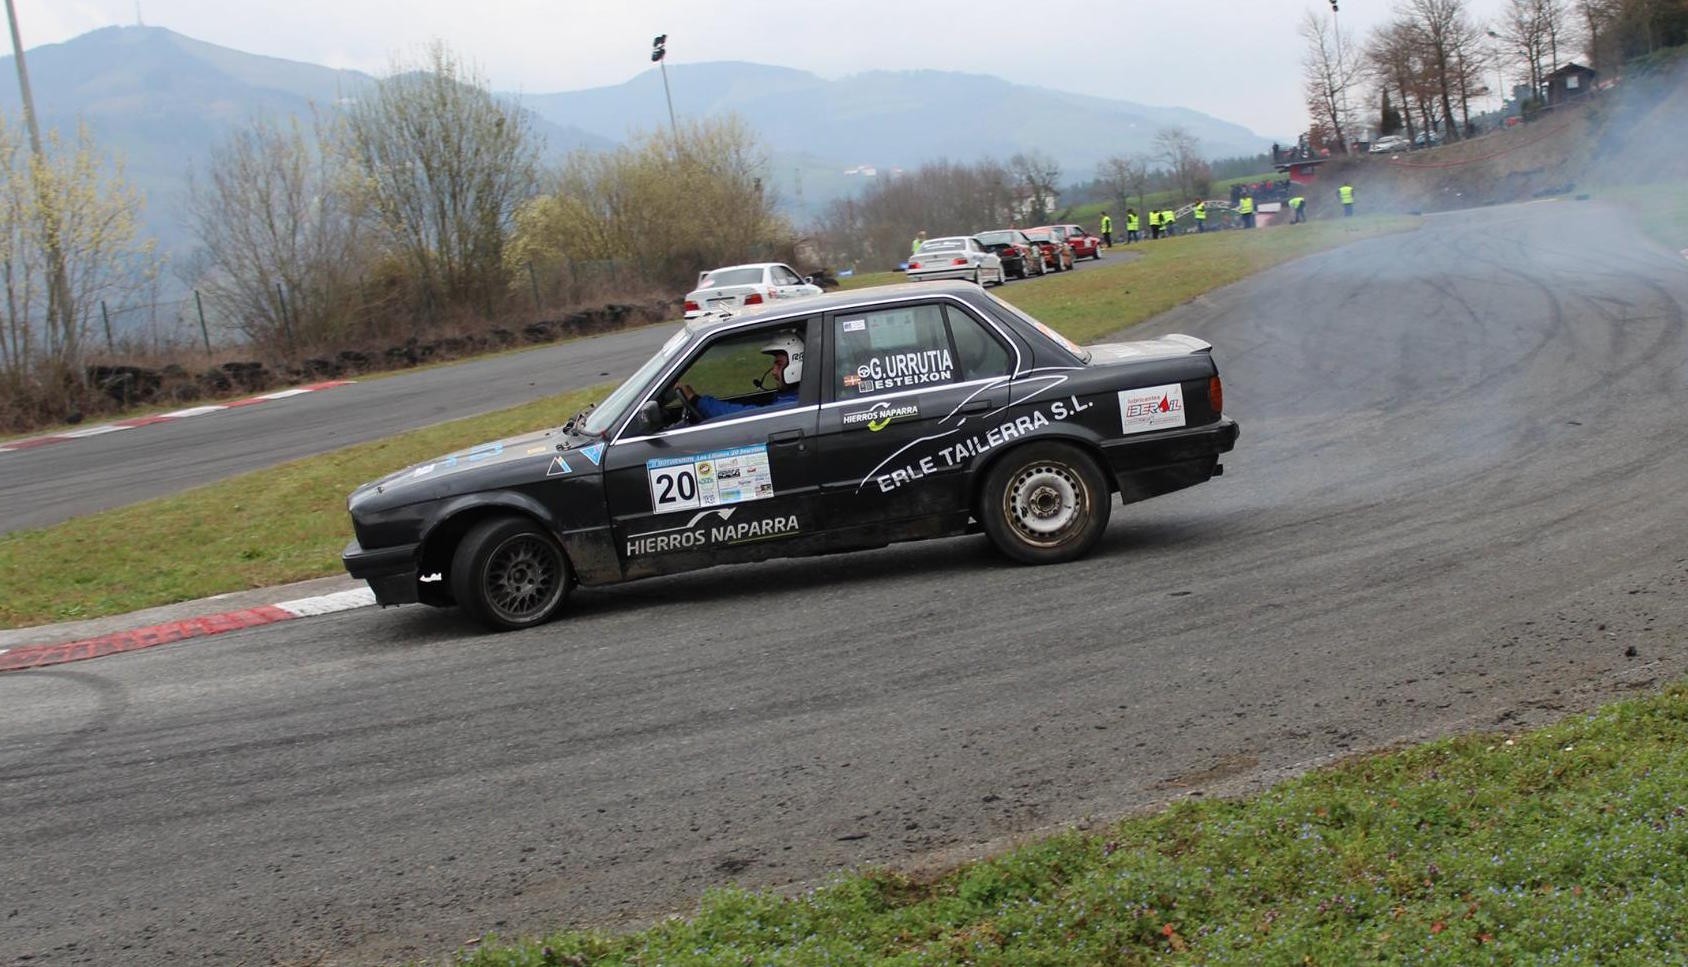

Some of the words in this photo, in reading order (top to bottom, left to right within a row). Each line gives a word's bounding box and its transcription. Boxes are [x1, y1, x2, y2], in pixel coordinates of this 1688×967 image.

[869, 349, 954, 380] G.URRUTIA
[875, 370, 951, 389] ESTEIXON
[843, 411, 879, 424] HIERROS
[879, 405, 918, 419] NAPARRA
[876, 456, 938, 494] ERLE
[938, 410, 1050, 467] TAILERRA
[1051, 394, 1094, 421] S.L.
[656, 471, 696, 505] 20
[626, 529, 706, 557] HIERROS
[711, 515, 800, 543] NAPARRA
